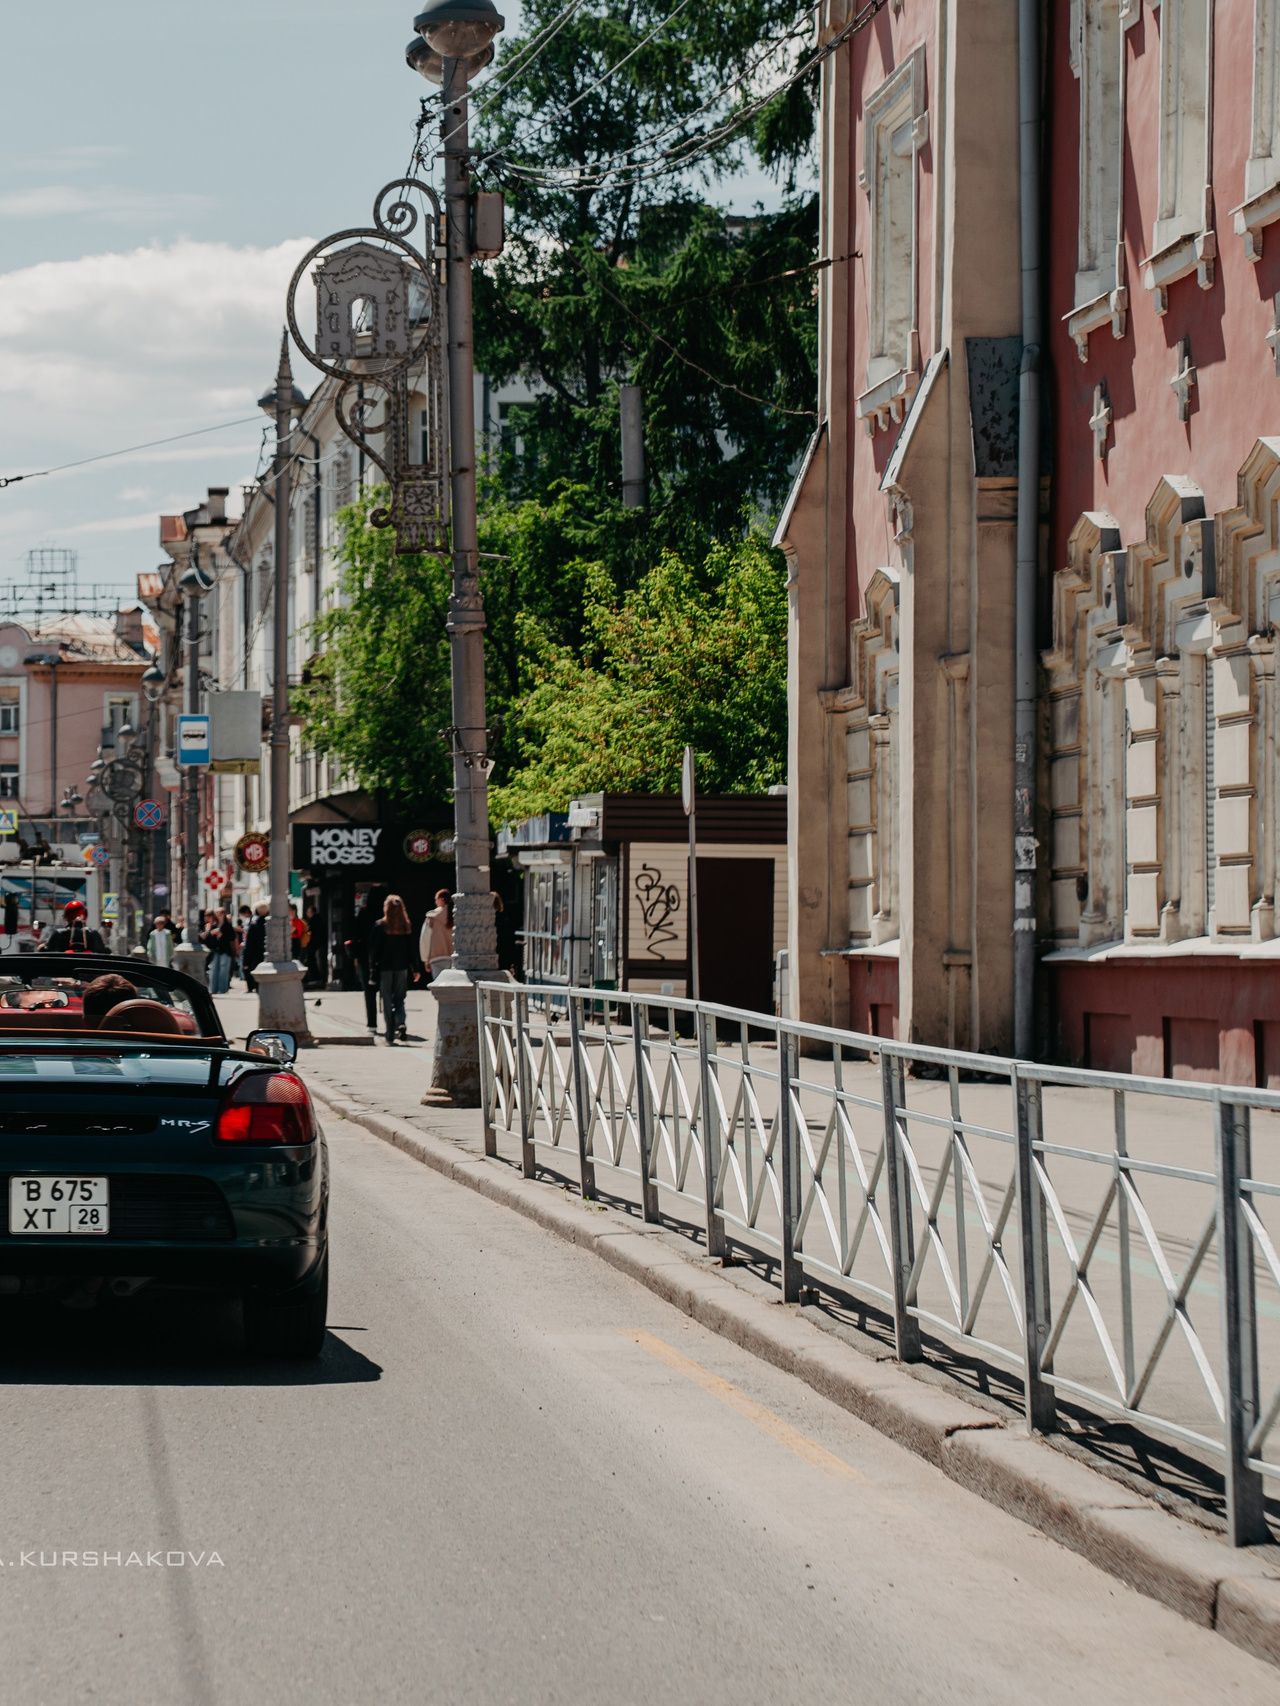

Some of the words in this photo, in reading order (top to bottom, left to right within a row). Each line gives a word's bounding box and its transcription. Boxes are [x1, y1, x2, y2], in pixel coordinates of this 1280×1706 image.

[311, 828, 382, 846] MONEY
[311, 846, 375, 864] ROSES
[161, 1118, 211, 1134] MR-S
[50, 1180, 93, 1201] 675
[78, 1208, 100, 1225] 28
